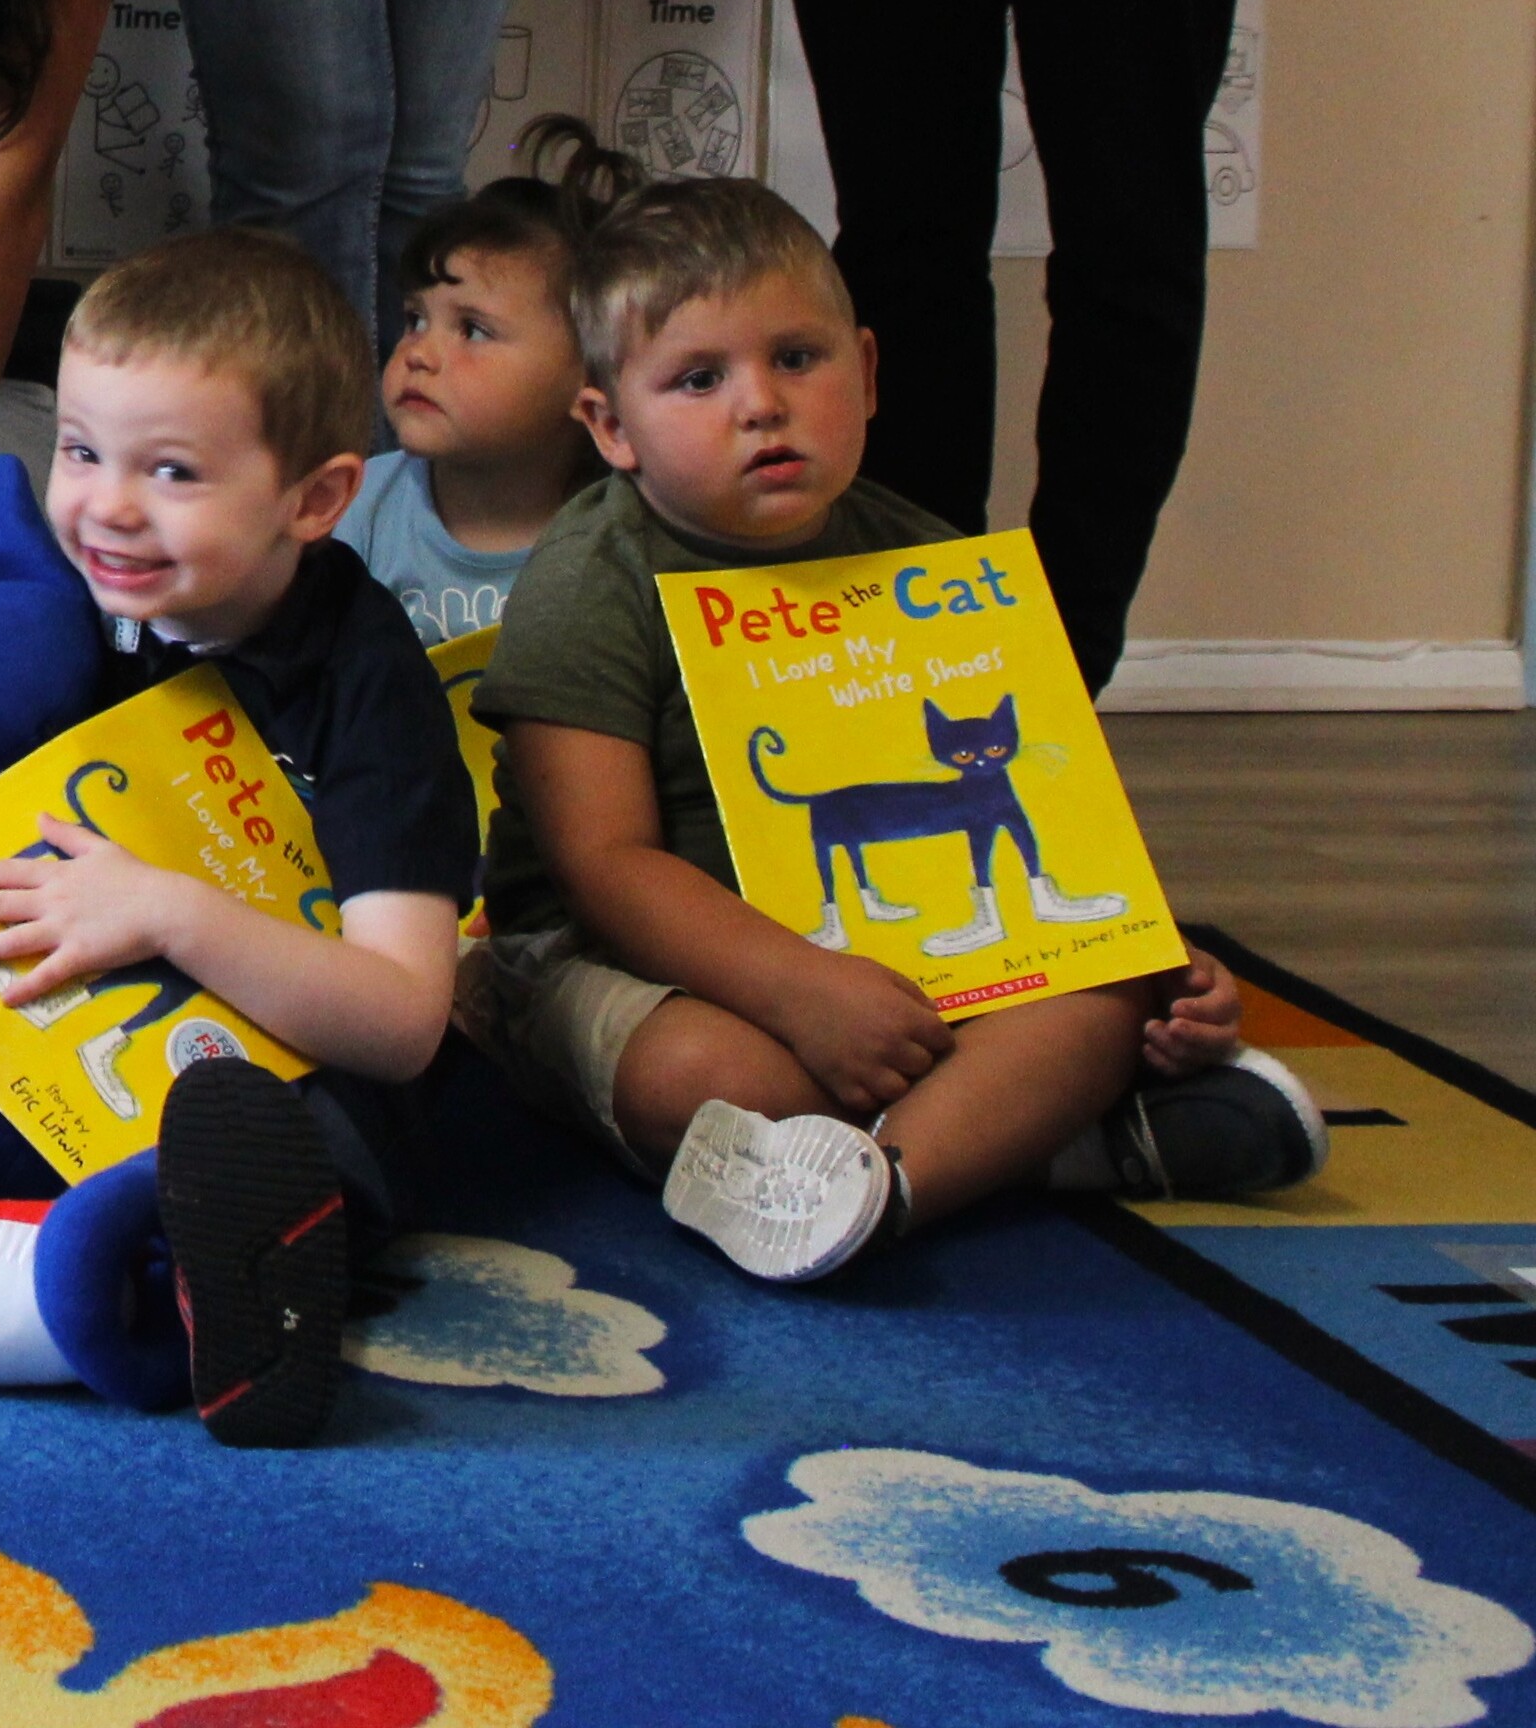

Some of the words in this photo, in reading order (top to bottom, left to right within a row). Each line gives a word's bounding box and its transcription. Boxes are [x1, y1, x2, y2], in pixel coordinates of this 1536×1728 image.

[114, 3, 182, 30] Time
[695, 585, 842, 648] Pete
[843, 579, 884, 610] the
[894, 556, 1019, 620] Cat
[747, 661, 759, 689] I
[770, 650, 835, 686] Love
[846, 634, 898, 667] My
[829, 671, 914, 710] White
[924, 646, 1006, 689] Shoes
[182, 709, 275, 846] Pete
[282, 839, 316, 879] the
[171, 772, 191, 787] I
[186, 791, 235, 849] Love
[237, 855, 277, 902] My
[916, 969, 954, 988] twin
[1003, 955, 1032, 972] Art
[1040, 944, 1062, 961] by
[1071, 928, 1115, 953] James
[1123, 917, 1159, 936] Dean
[10, 1076, 41, 1113] Eric
[39, 1111, 88, 1169] Litwin
[45, 1083, 75, 1114] Story
[74, 1115, 91, 1133] by
